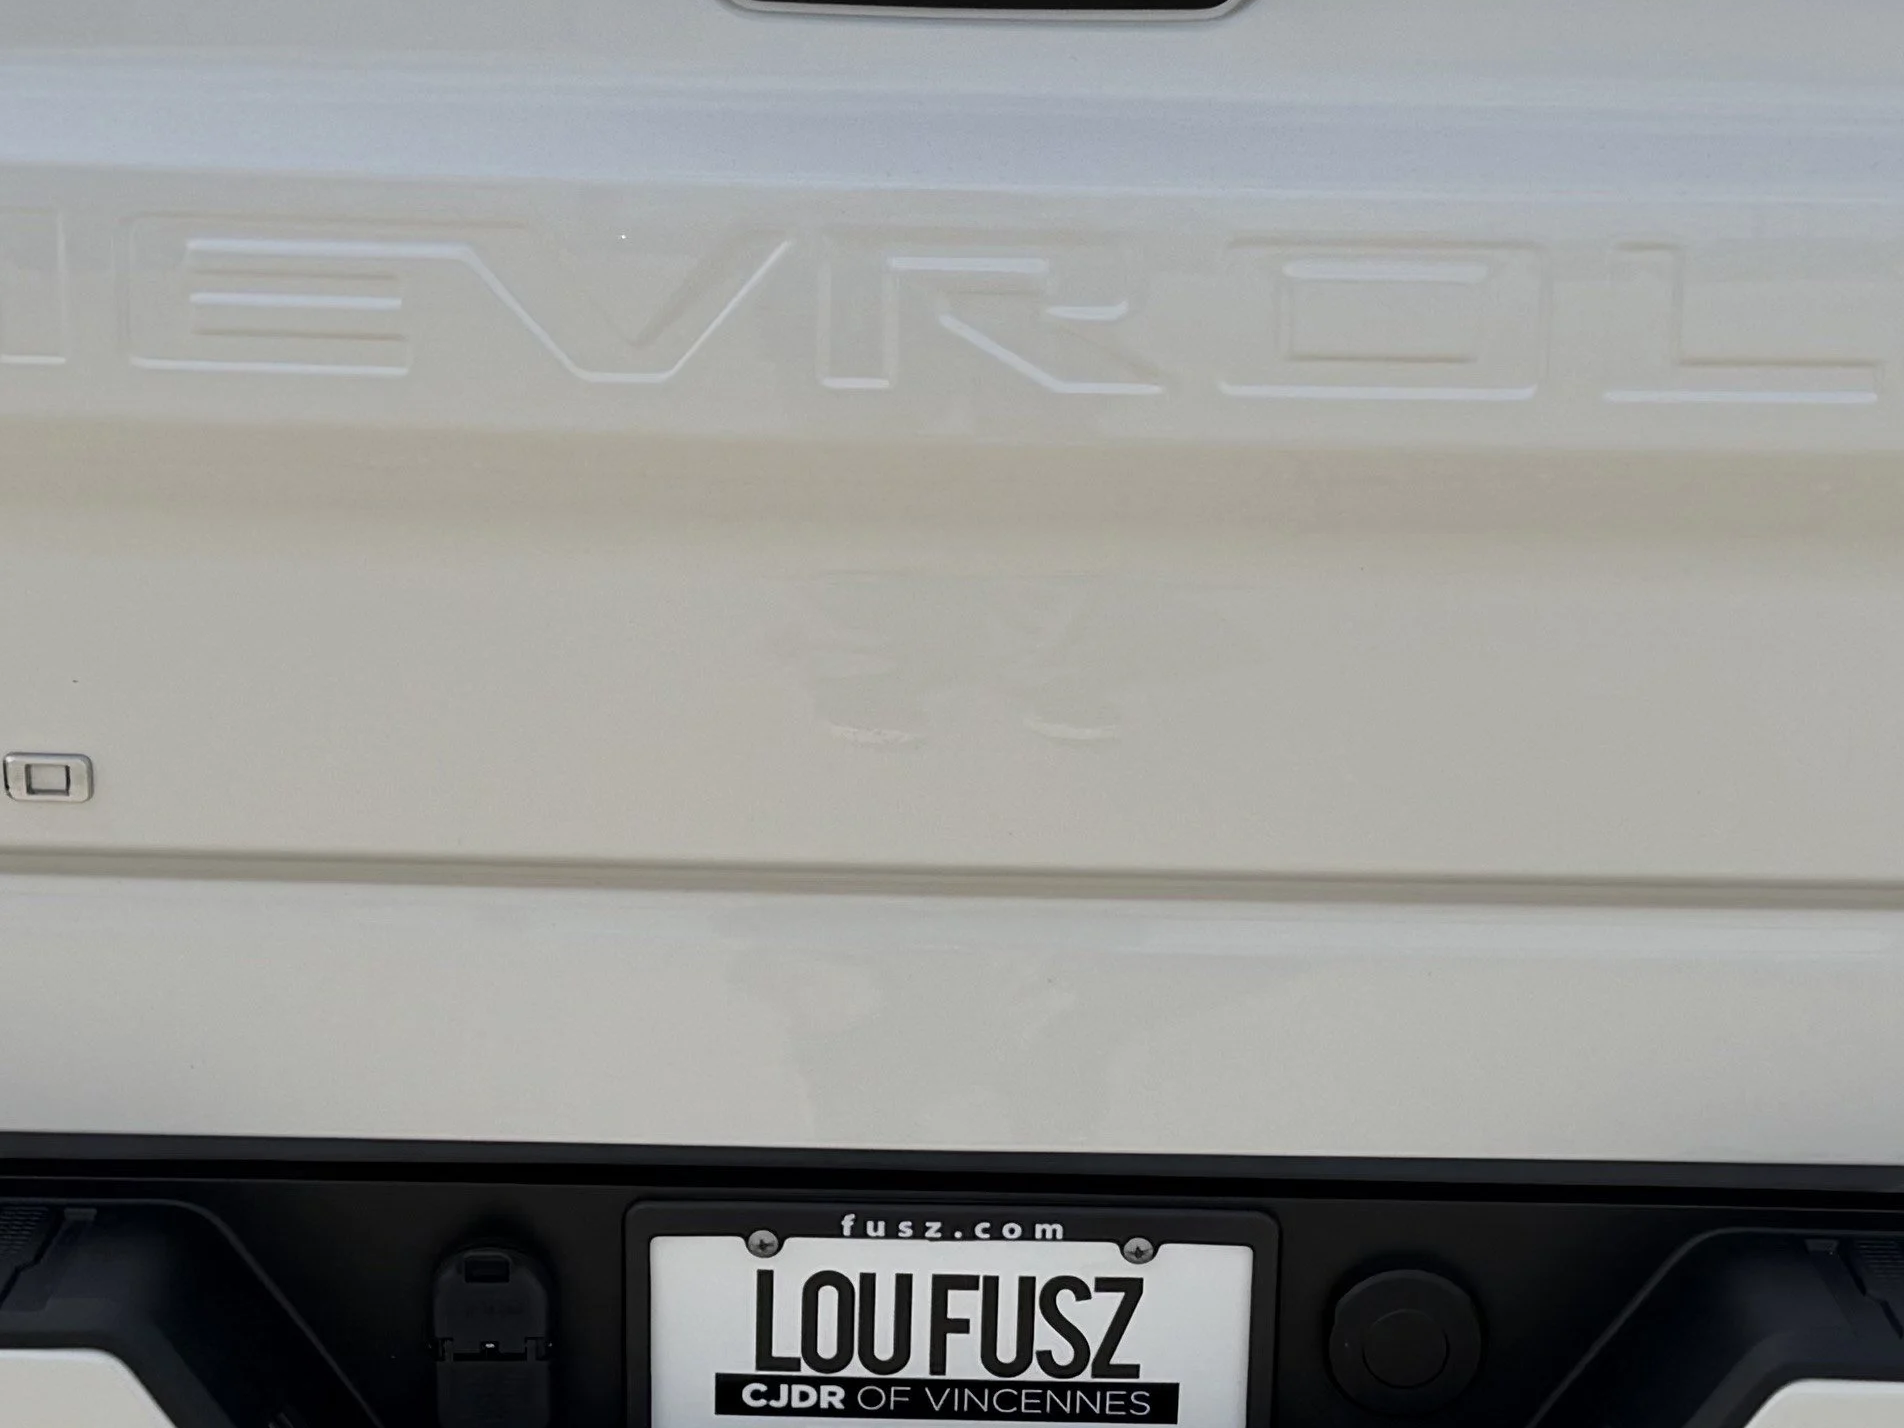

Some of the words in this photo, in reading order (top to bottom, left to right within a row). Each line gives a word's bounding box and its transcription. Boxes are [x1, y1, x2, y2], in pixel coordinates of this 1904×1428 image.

[840, 1212, 1065, 1240] fusz.com
[754, 1269, 913, 1375] LOU
[928, 1274, 1145, 1380] FUSZ
[741, 1382, 846, 1410] CJDR
[857, 1385, 912, 1412] OF
[924, 1386, 1152, 1417] VINCENNES
